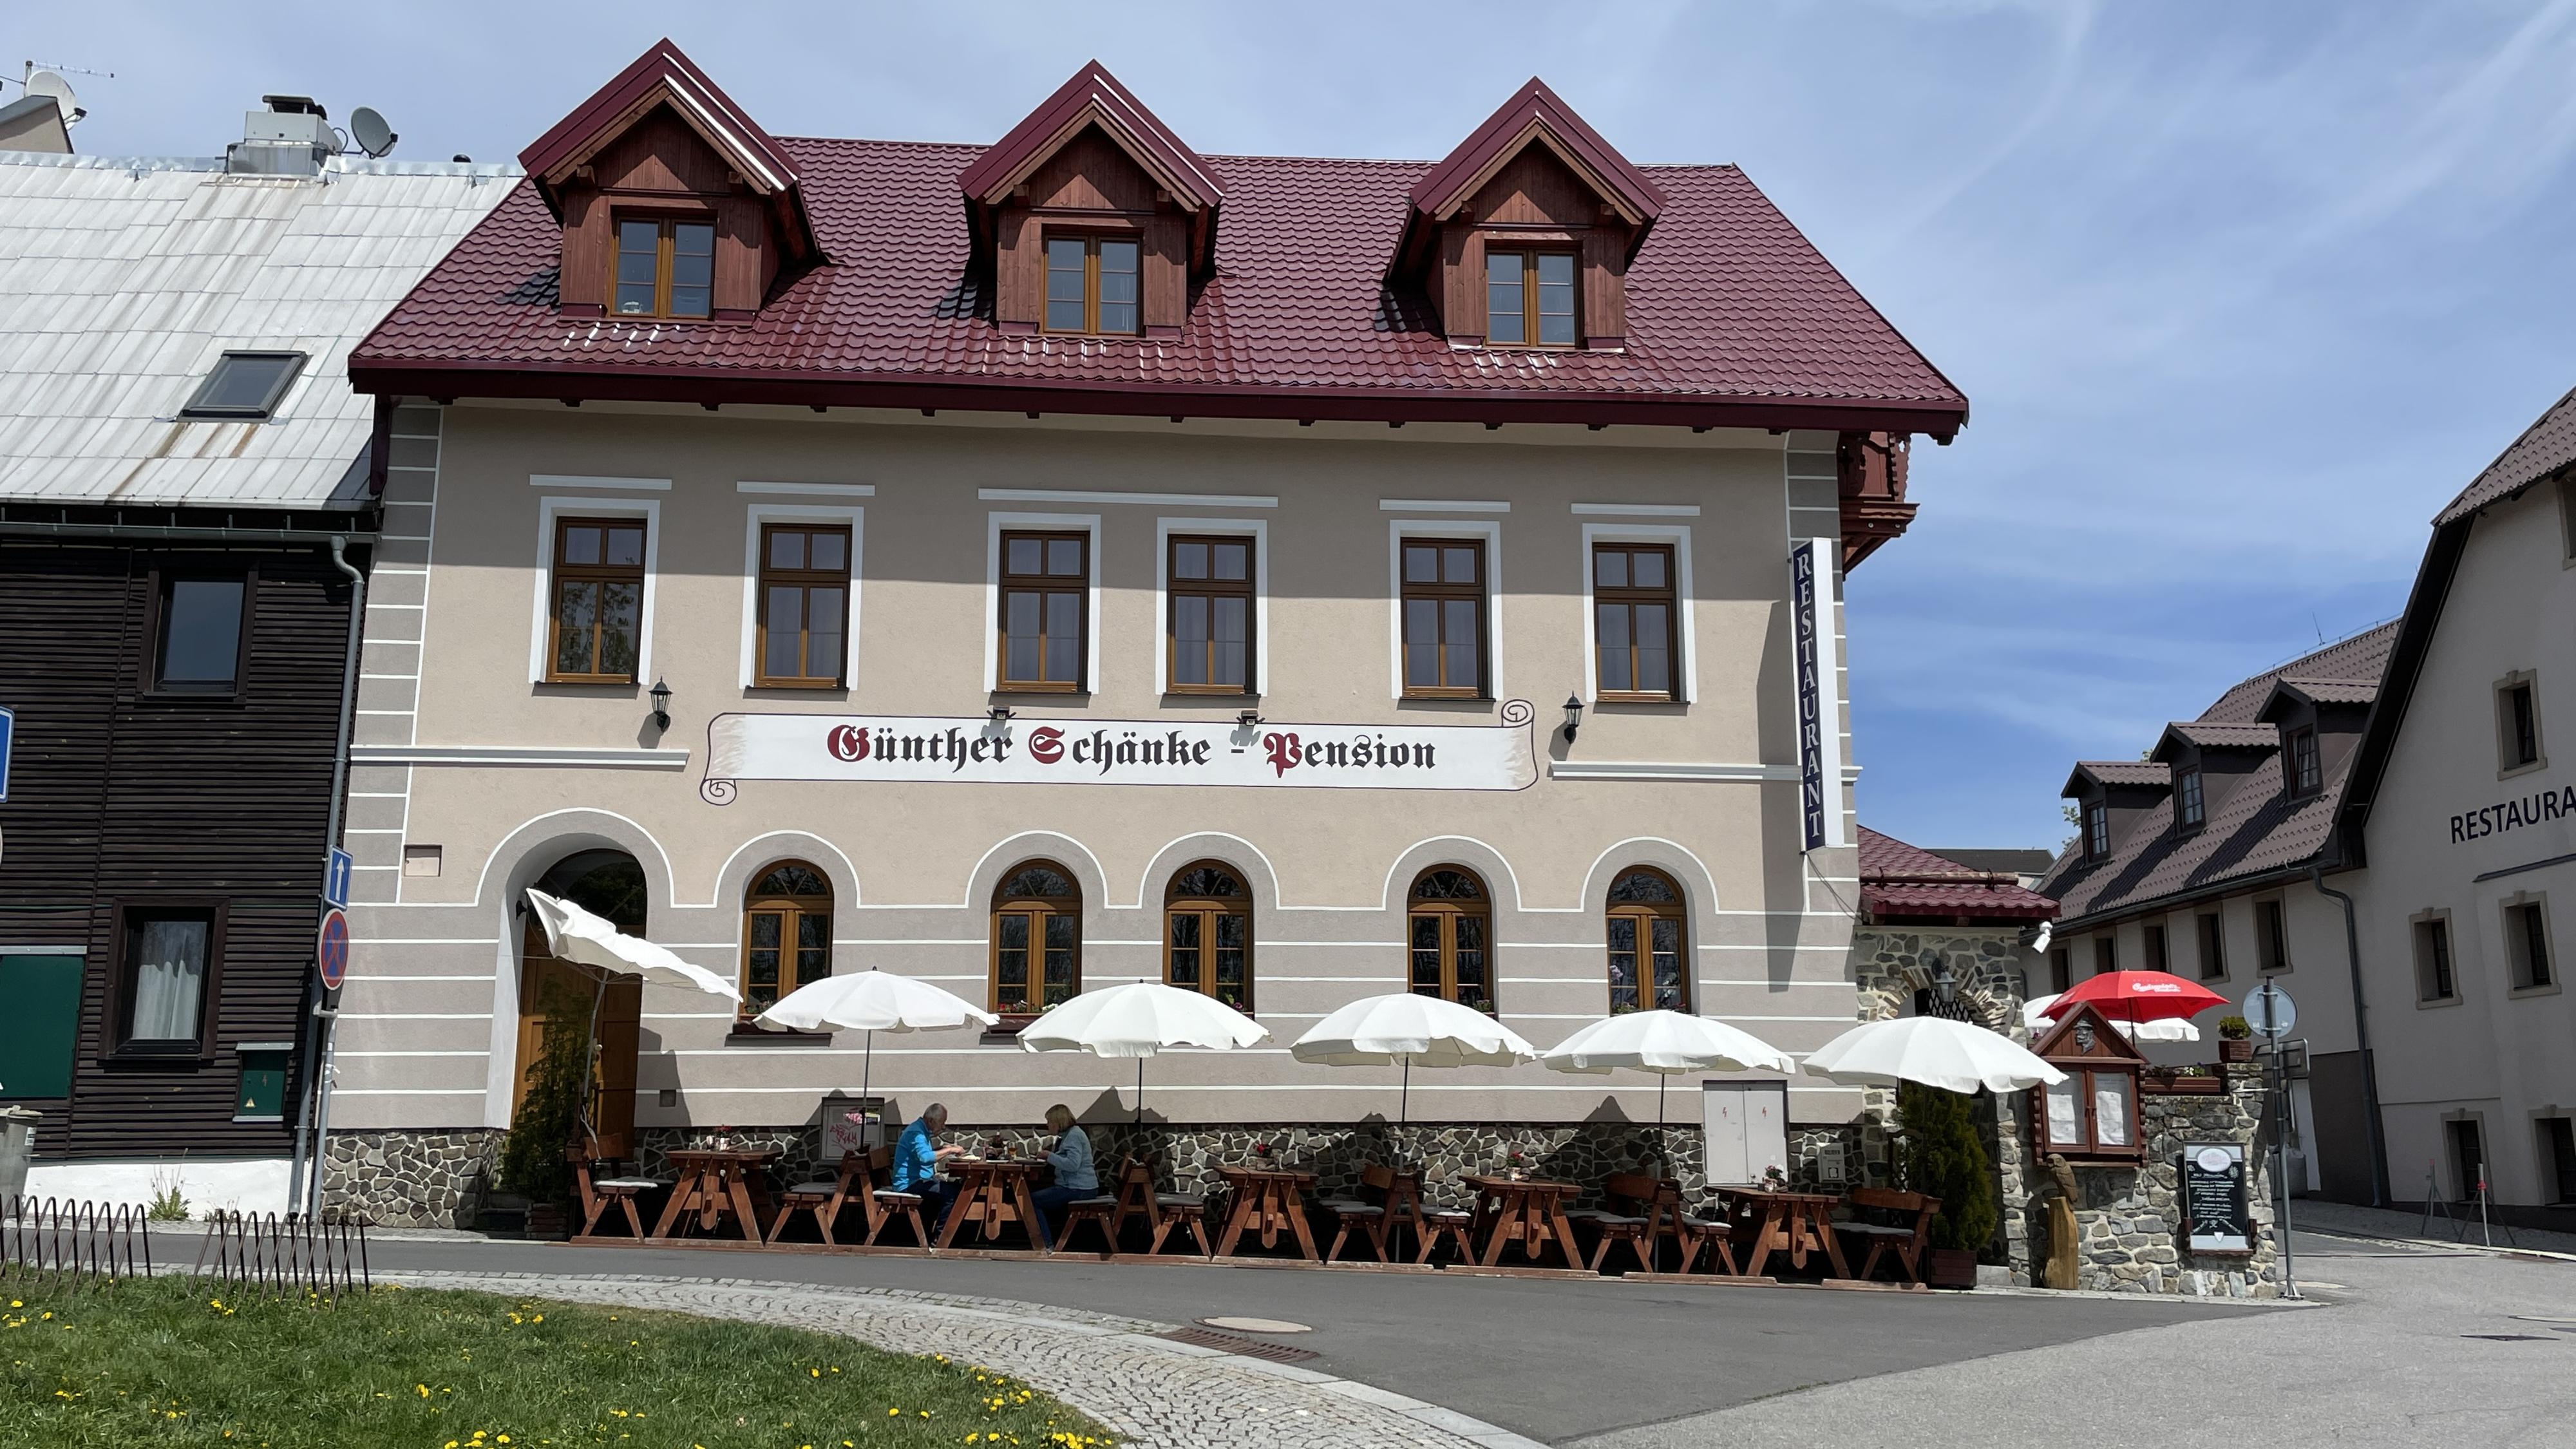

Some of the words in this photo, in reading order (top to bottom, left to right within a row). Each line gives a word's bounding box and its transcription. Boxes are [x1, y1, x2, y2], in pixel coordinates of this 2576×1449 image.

[1796, 553, 1821, 838] RESTAURANT
[827, 724, 1013, 773] Günther
[1028, 726, 1211, 776] Schänke
[1263, 732, 1435, 778] Pension
[2450, 785, 2576, 844] RESTAURA
